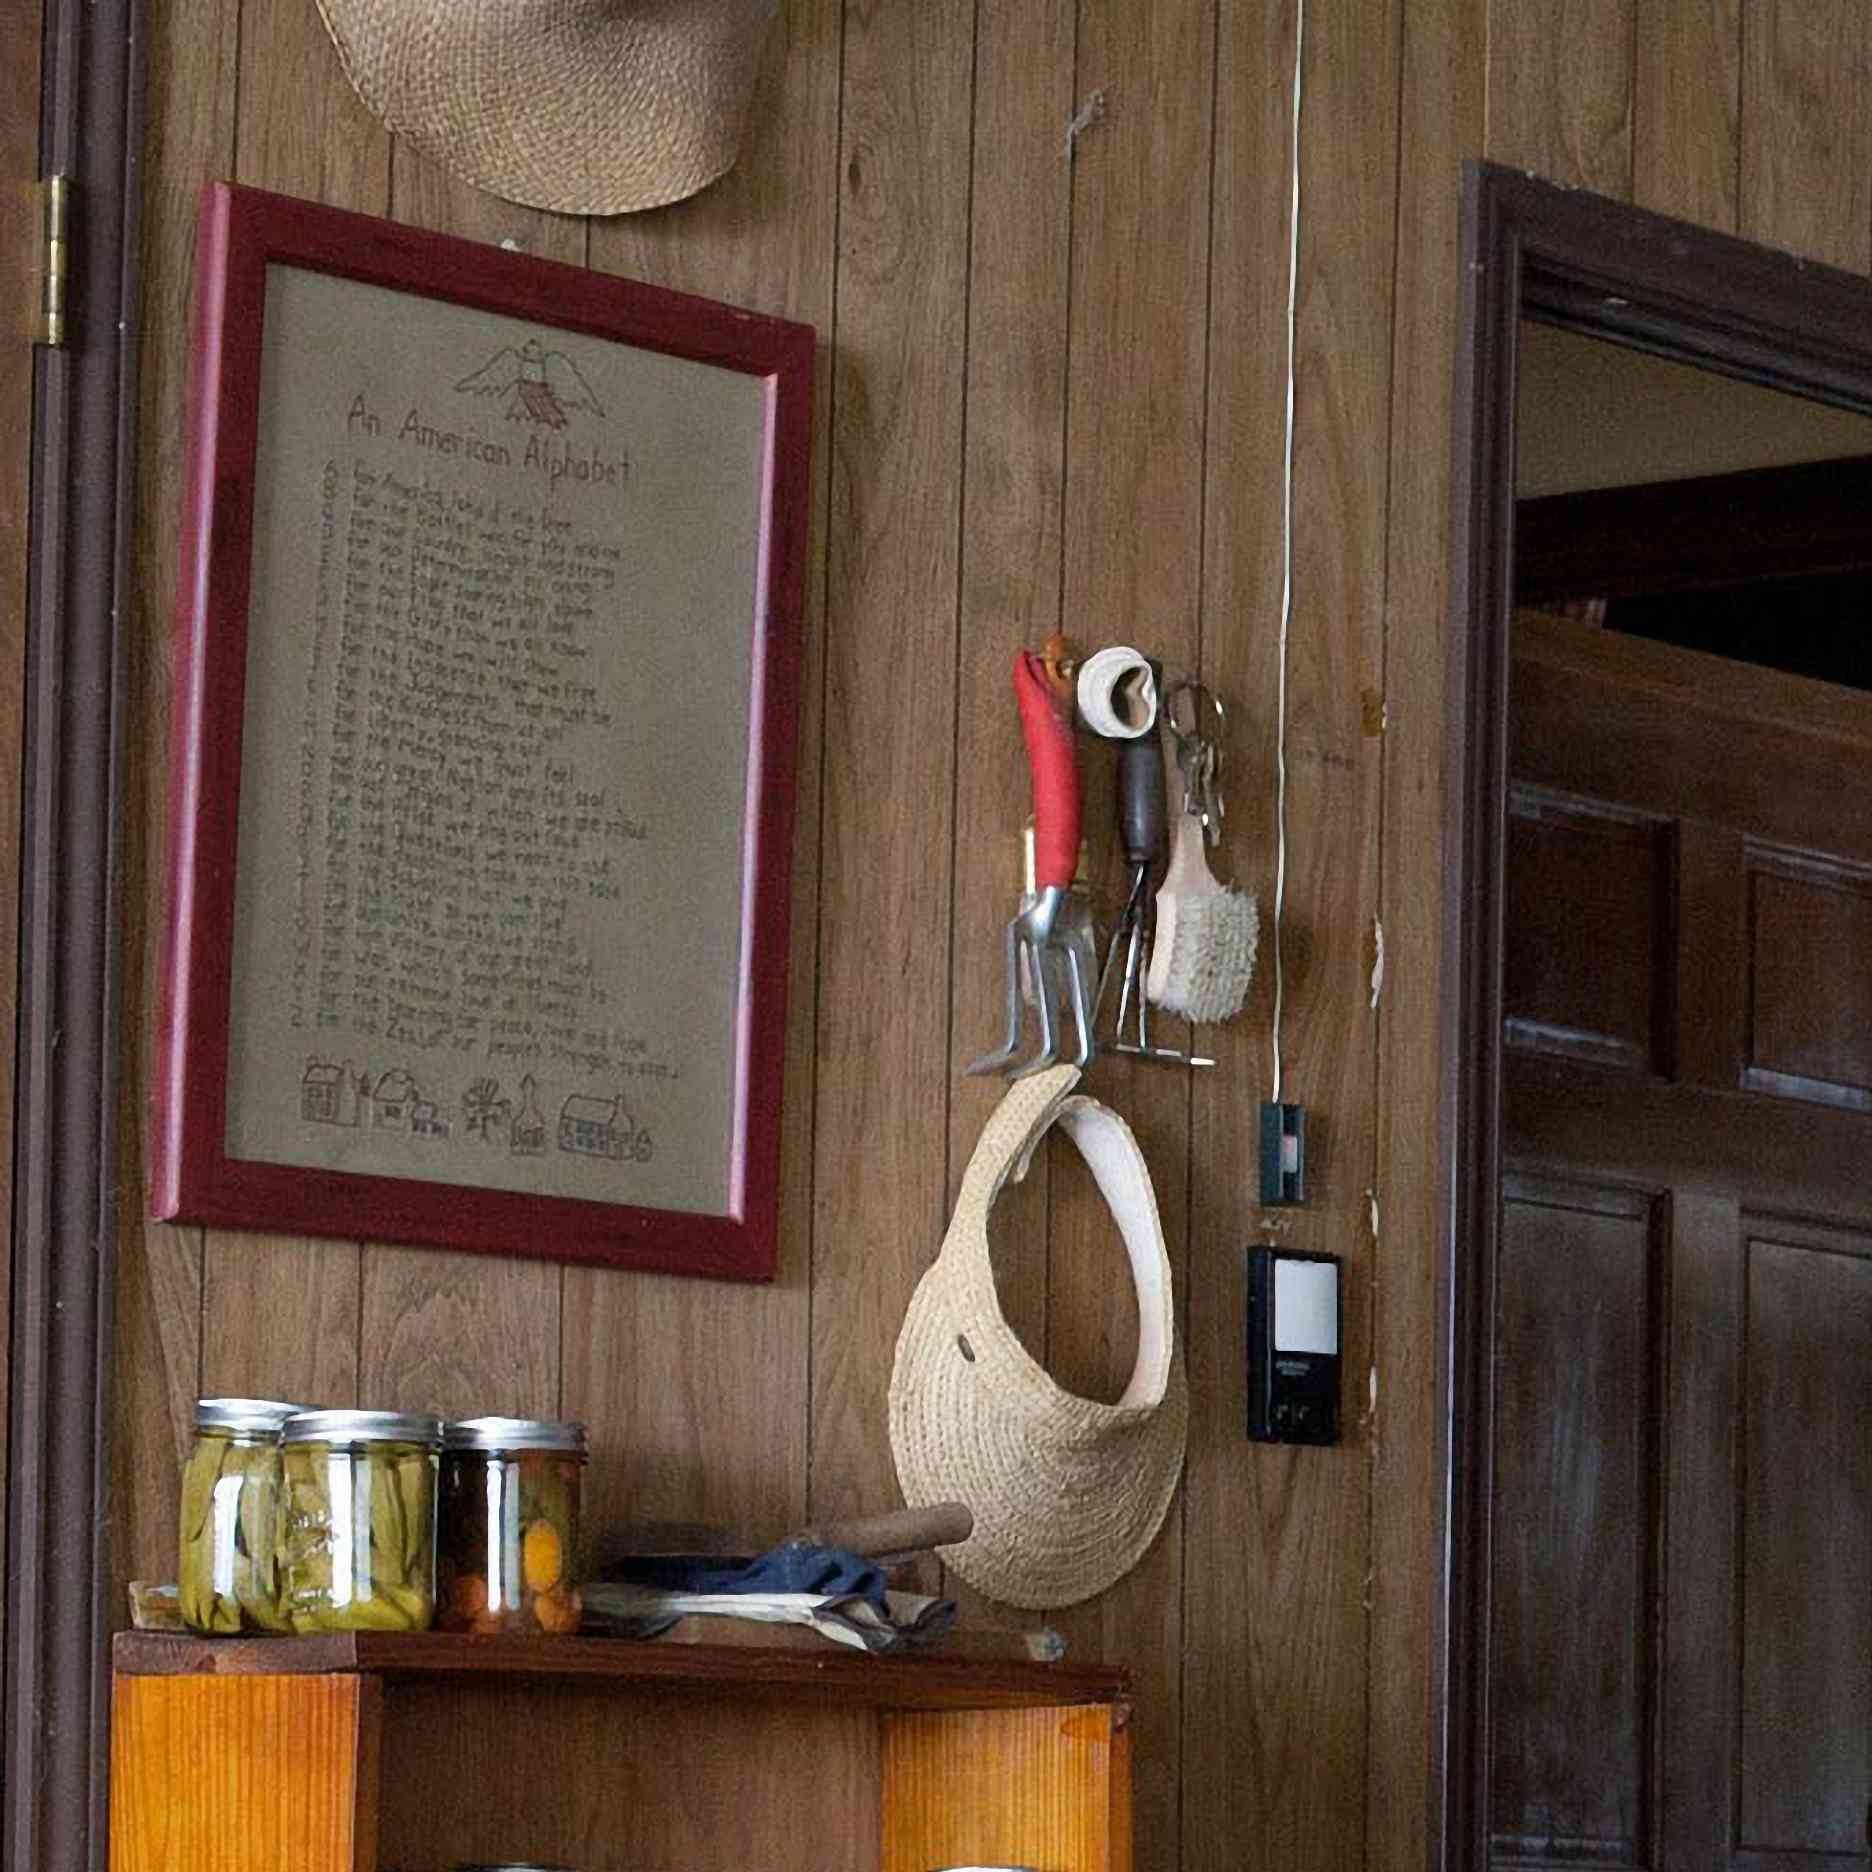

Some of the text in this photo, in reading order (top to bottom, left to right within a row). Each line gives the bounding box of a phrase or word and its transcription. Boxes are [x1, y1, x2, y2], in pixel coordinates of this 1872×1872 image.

[348, 392, 632, 494] An American Alphabet
